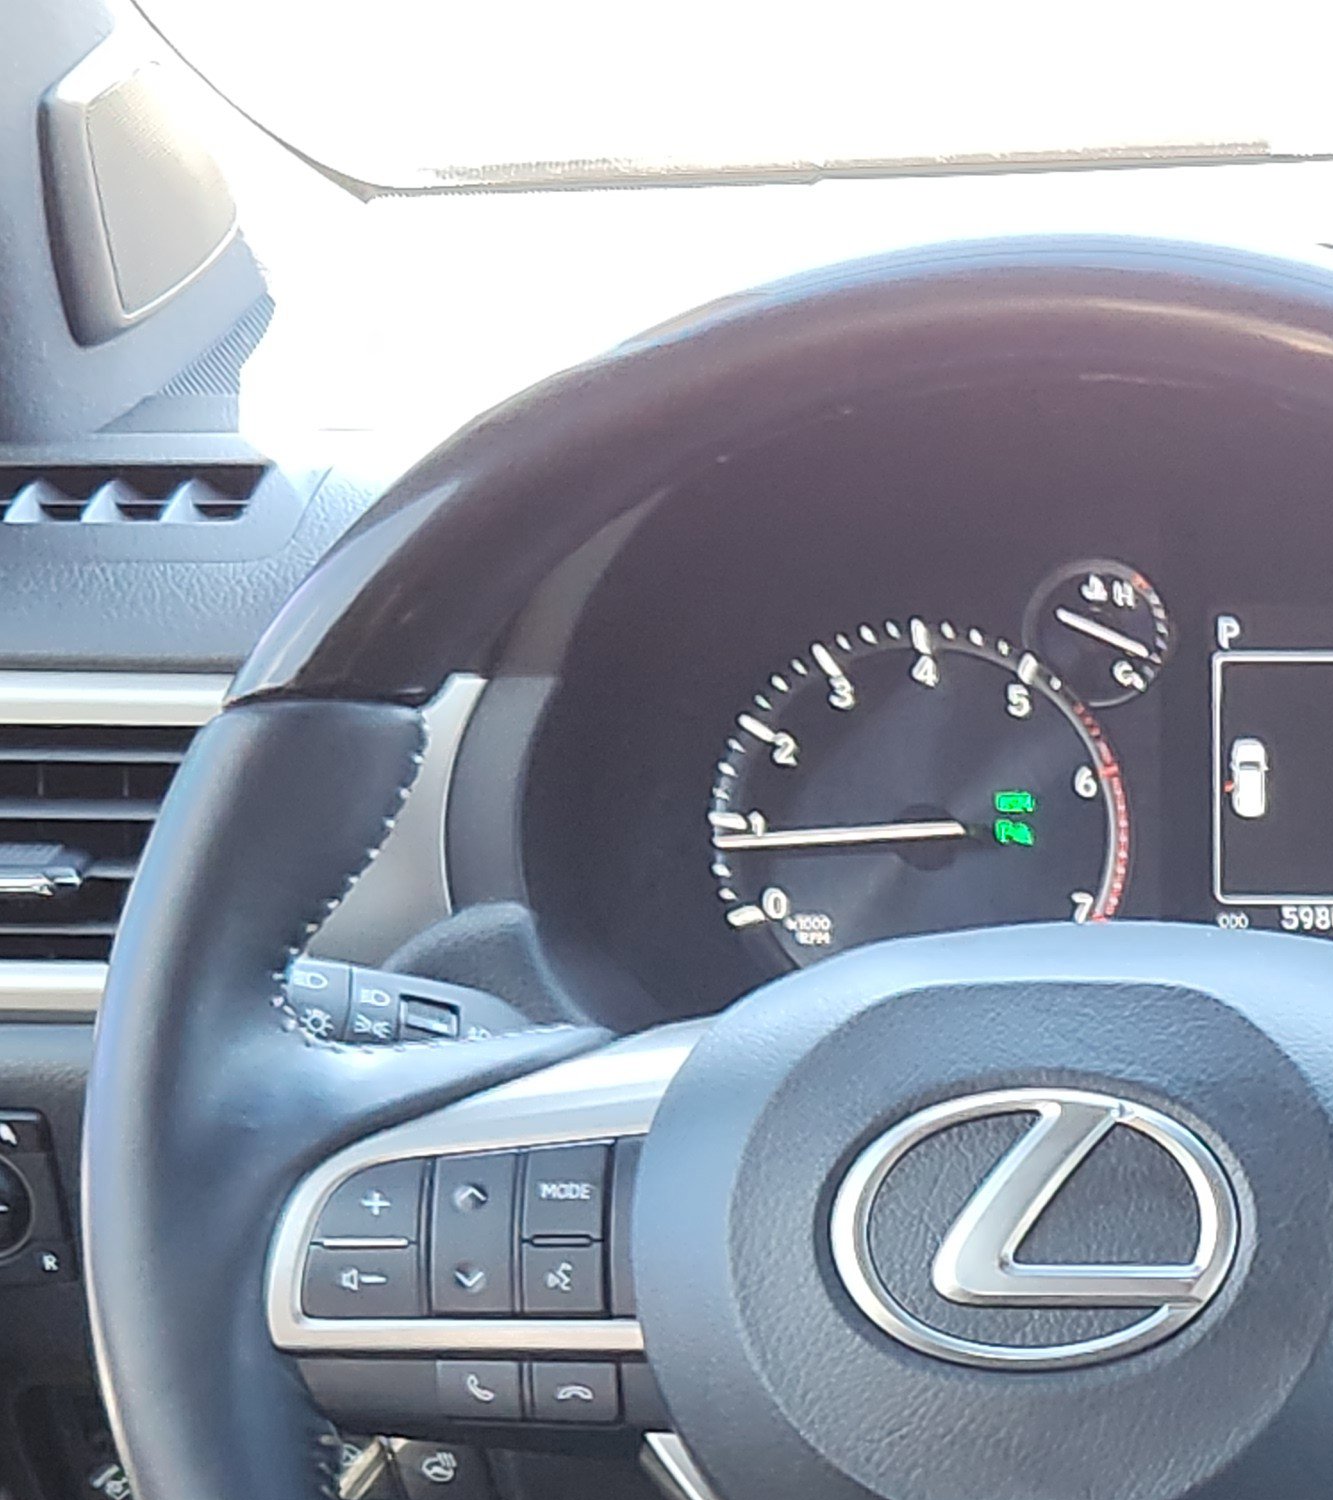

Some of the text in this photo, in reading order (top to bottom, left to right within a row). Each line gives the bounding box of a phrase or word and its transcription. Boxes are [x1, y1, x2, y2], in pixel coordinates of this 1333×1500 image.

[1113, 580, 1134, 608] H
[1218, 616, 1240, 648] P
[912, 659, 938, 687] 4
[830, 676, 855, 709] 3
[1008, 685, 1030, 717] 5
[773, 732, 796, 765] 2
[1074, 766, 1096, 798] 6
[762, 887, 788, 920] 0
[1072, 891, 1093, 924] 7
[540, 1183, 591, 1200] MODE
[42, 1252, 60, 1272] R
